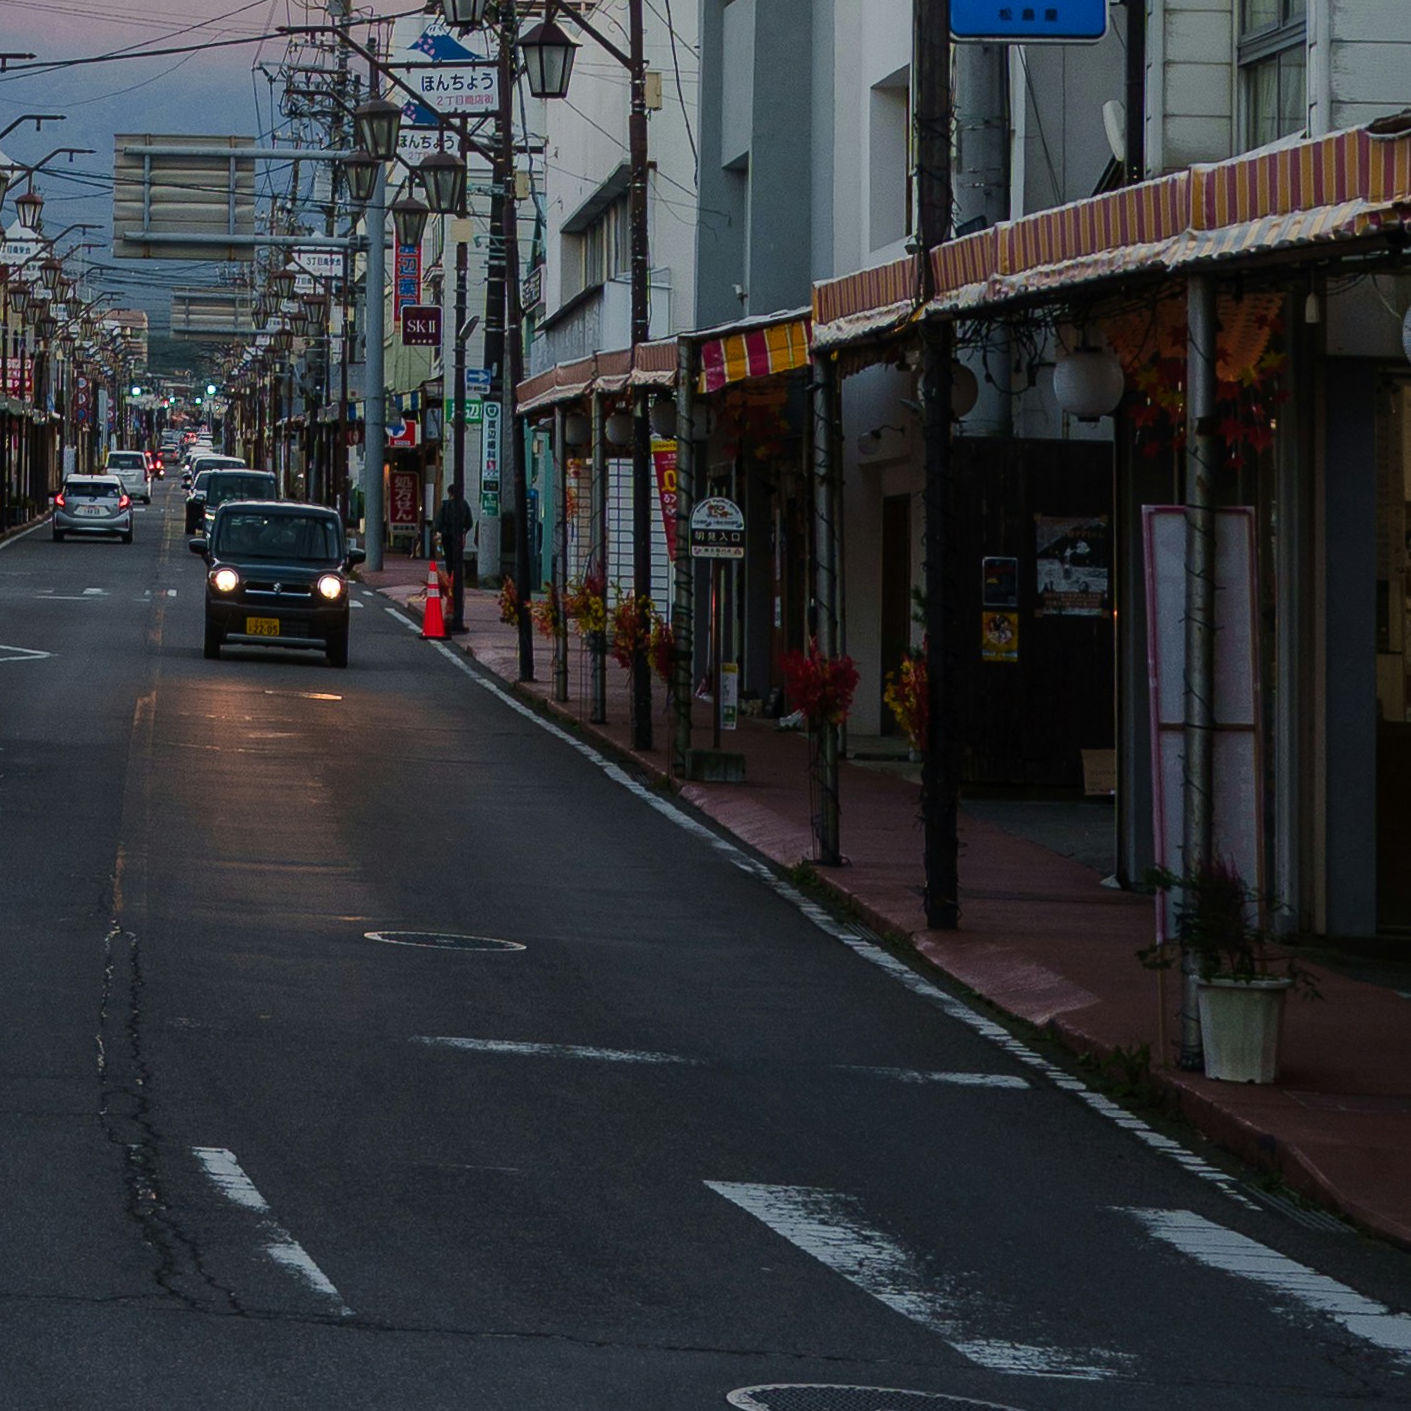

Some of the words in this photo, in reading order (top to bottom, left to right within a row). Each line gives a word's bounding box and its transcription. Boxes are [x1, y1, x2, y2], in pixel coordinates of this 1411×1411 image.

[420, 72, 494, 92] ほんちょう
[435, 93, 494, 108] 2丁目商店街
[394, 475, 413, 521] 処方せん
